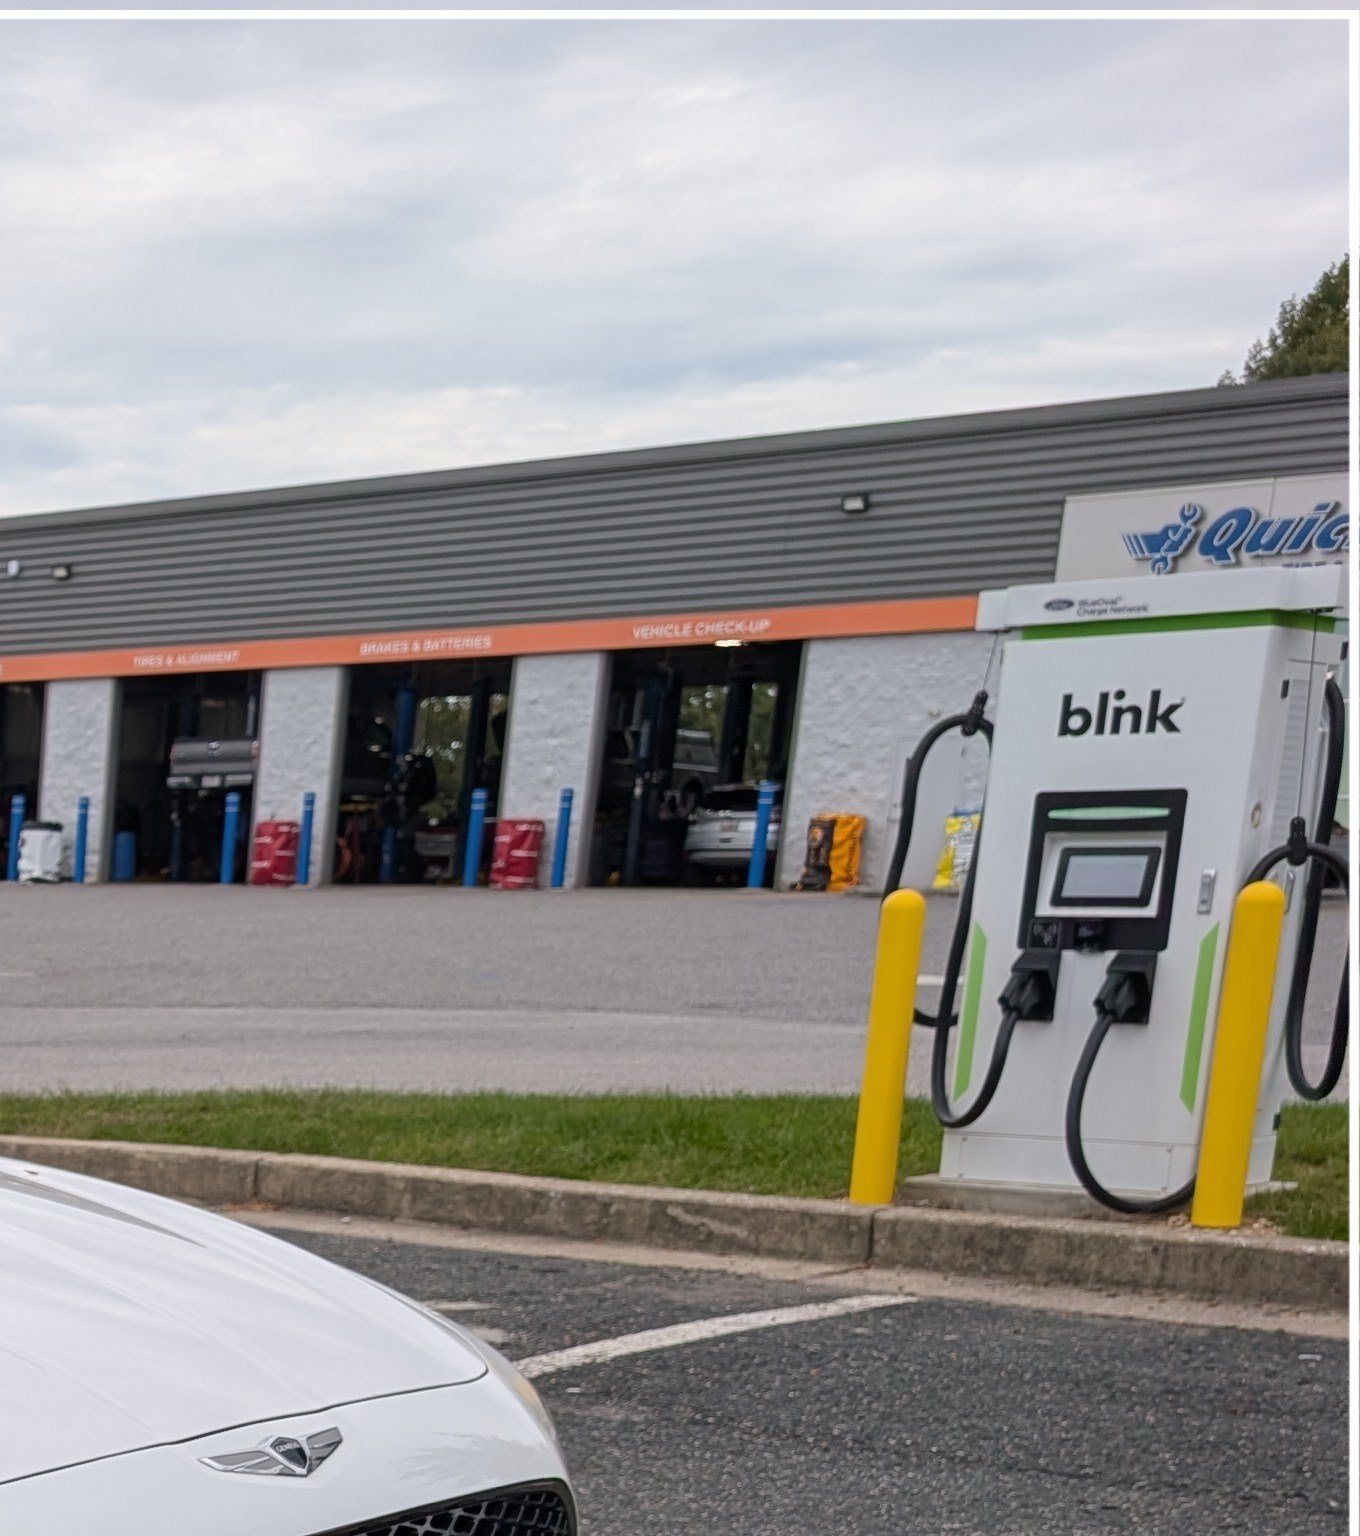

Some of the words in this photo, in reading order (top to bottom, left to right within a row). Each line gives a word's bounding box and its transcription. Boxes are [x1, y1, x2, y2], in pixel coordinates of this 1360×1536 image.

[1197, 500, 1349, 565] Quic
[633, 622, 692, 640] VEHICLE
[695, 618, 771, 637] CHECK-UP
[360, 639, 409, 656] BRAKES
[411, 639, 421, 654] &
[423, 634, 494, 653] BATTERIES
[133, 654, 164, 668] TIRES
[176, 650, 240, 666] ALIGNMENT
[1058, 689, 1183, 737] blink
